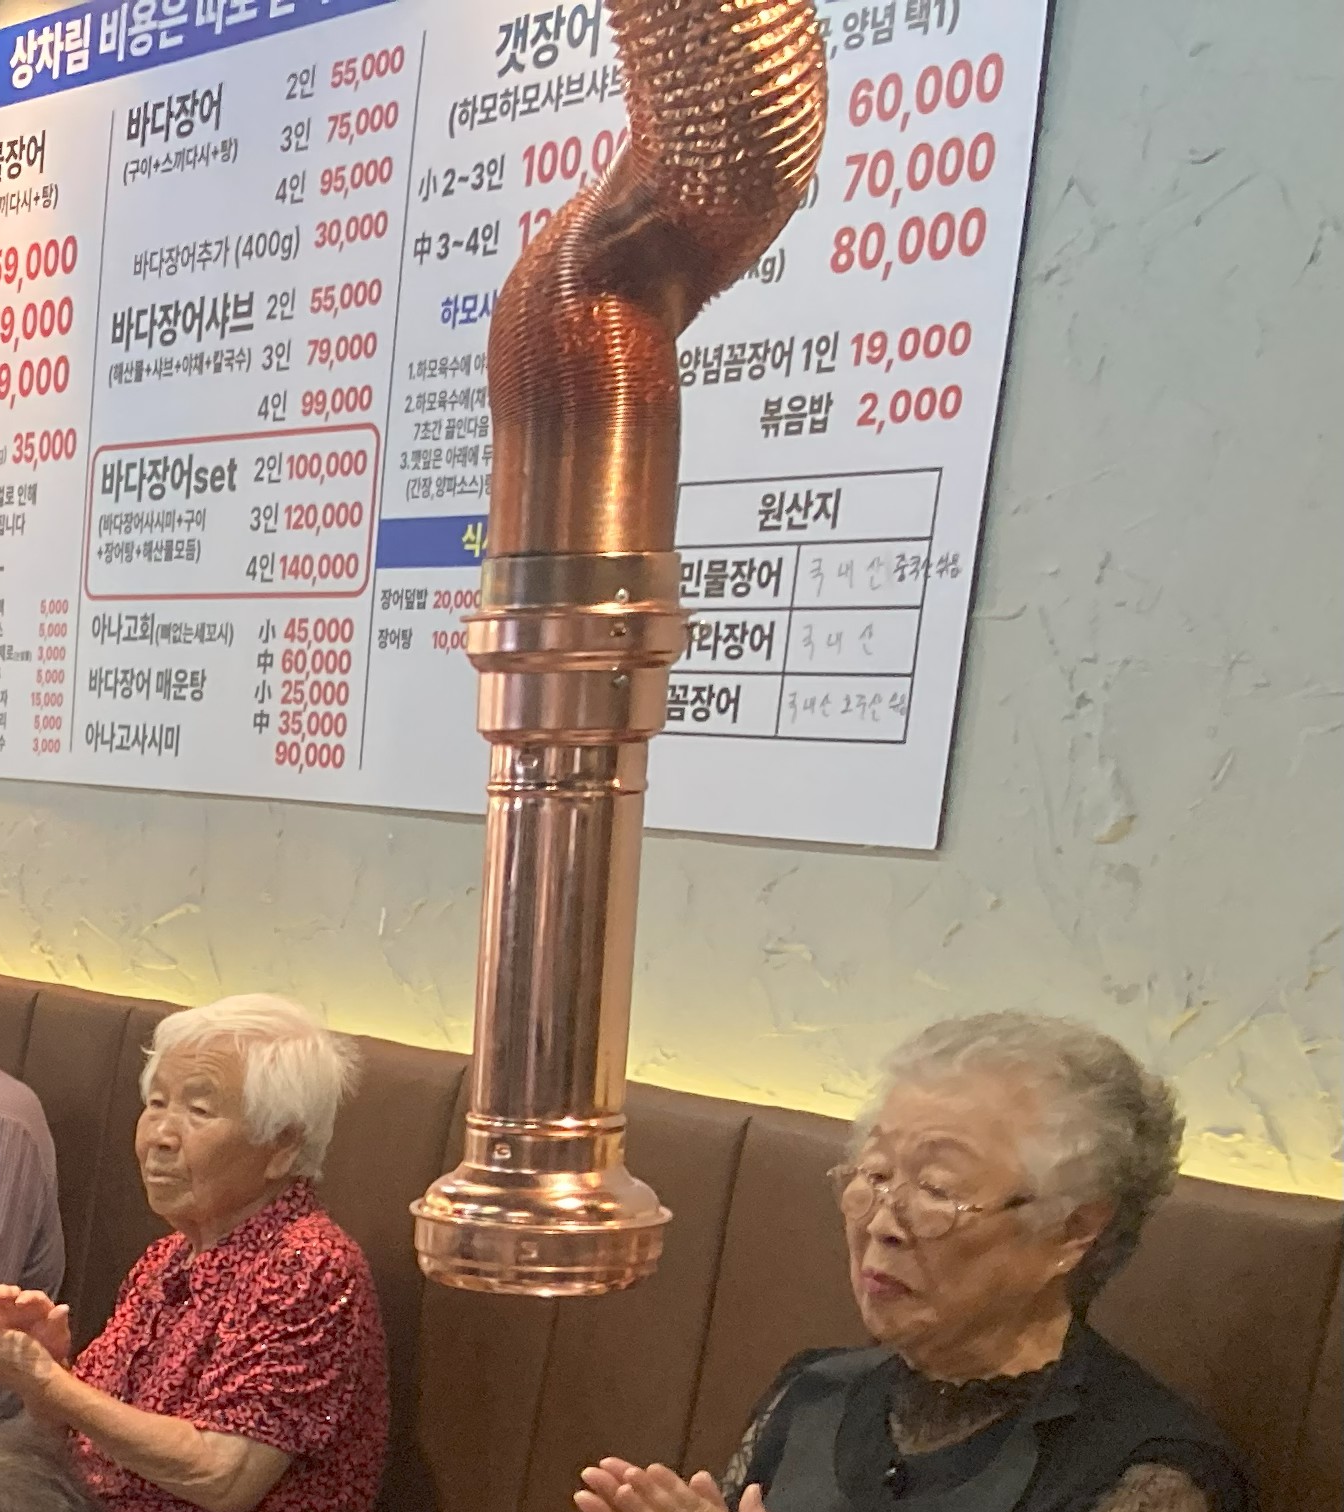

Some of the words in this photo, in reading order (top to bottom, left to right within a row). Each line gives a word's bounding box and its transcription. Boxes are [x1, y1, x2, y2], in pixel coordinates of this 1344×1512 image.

[10, 12, 91, 90] 상차림
[98, 0, 189, 62] 비용은
[496, 0, 602, 78] 갯장어
[286, 64, 316, 100] 2인
[331, 45, 404, 91] 55,000
[849, 52, 1004, 132] 60,000
[126, 81, 223, 147] 바다장어
[280, 118, 310, 152] 3인
[327, 101, 399, 145] 75,000
[275, 170, 306, 204] 4인
[320, 156, 393, 199] 95,000
[442, 154, 506, 197] 2~3인
[522, 127, 629, 188] 100,0
[843, 131, 995, 208] 70,000
[133, 236, 230, 280] 바다장어추가
[234, 226, 300, 269] (400g)
[314, 210, 388, 252] 30,000
[414, 232, 432, 265] 中
[437, 220, 500, 261] 3~4인
[830, 207, 986, 281] 80,000
[112, 291, 254, 352] 바다장어샤브
[266, 287, 295, 321] 2인
[310, 278, 382, 318] 55,000
[262, 339, 291, 371] 3인
[307, 331, 377, 371] 79,000
[680, 335, 795, 387] 양념꼼장어
[802, 330, 839, 375] 1인
[850, 320, 972, 373] 19,000
[257, 391, 287, 422] 4인
[301, 385, 372, 422] 99,000
[760, 391, 833, 438] 볶음밥
[856, 384, 963, 435] 2,000
[12, 427, 76, 471] 35,000
[253, 452, 283, 484] 2인
[286, 449, 368, 485] 100,000
[101, 454, 237, 503] 바다장어set
[250, 503, 279, 534] 3인
[284, 501, 363, 537] 120,000
[758, 487, 842, 532] 원산지
[462, 522, 489, 558] 식
[245, 551, 275, 582] 4인
[279, 552, 359, 586] 140,000
[680, 556, 783, 598] 민물장어
[40, 599, 68, 617] 5,000
[39, 623, 67, 641] 5,000
[284, 617, 354, 650] 45,000
[36, 669, 64, 686] 5,000
[257, 649, 274, 675] 中
[281, 648, 352, 681] 60,000
[88, 666, 151, 700] 바다장어
[156, 668, 207, 701] 매운탕
[280, 680, 349, 712] 25,000
[667, 684, 741, 723] 꼼장어
[34, 715, 61, 733] 5,000
[253, 710, 270, 734] 中
[278, 711, 347, 742] 35,000
[33, 738, 60, 756] 3,000
[85, 720, 180, 758] 아나고사시미
[275, 741, 345, 774] 90,000
